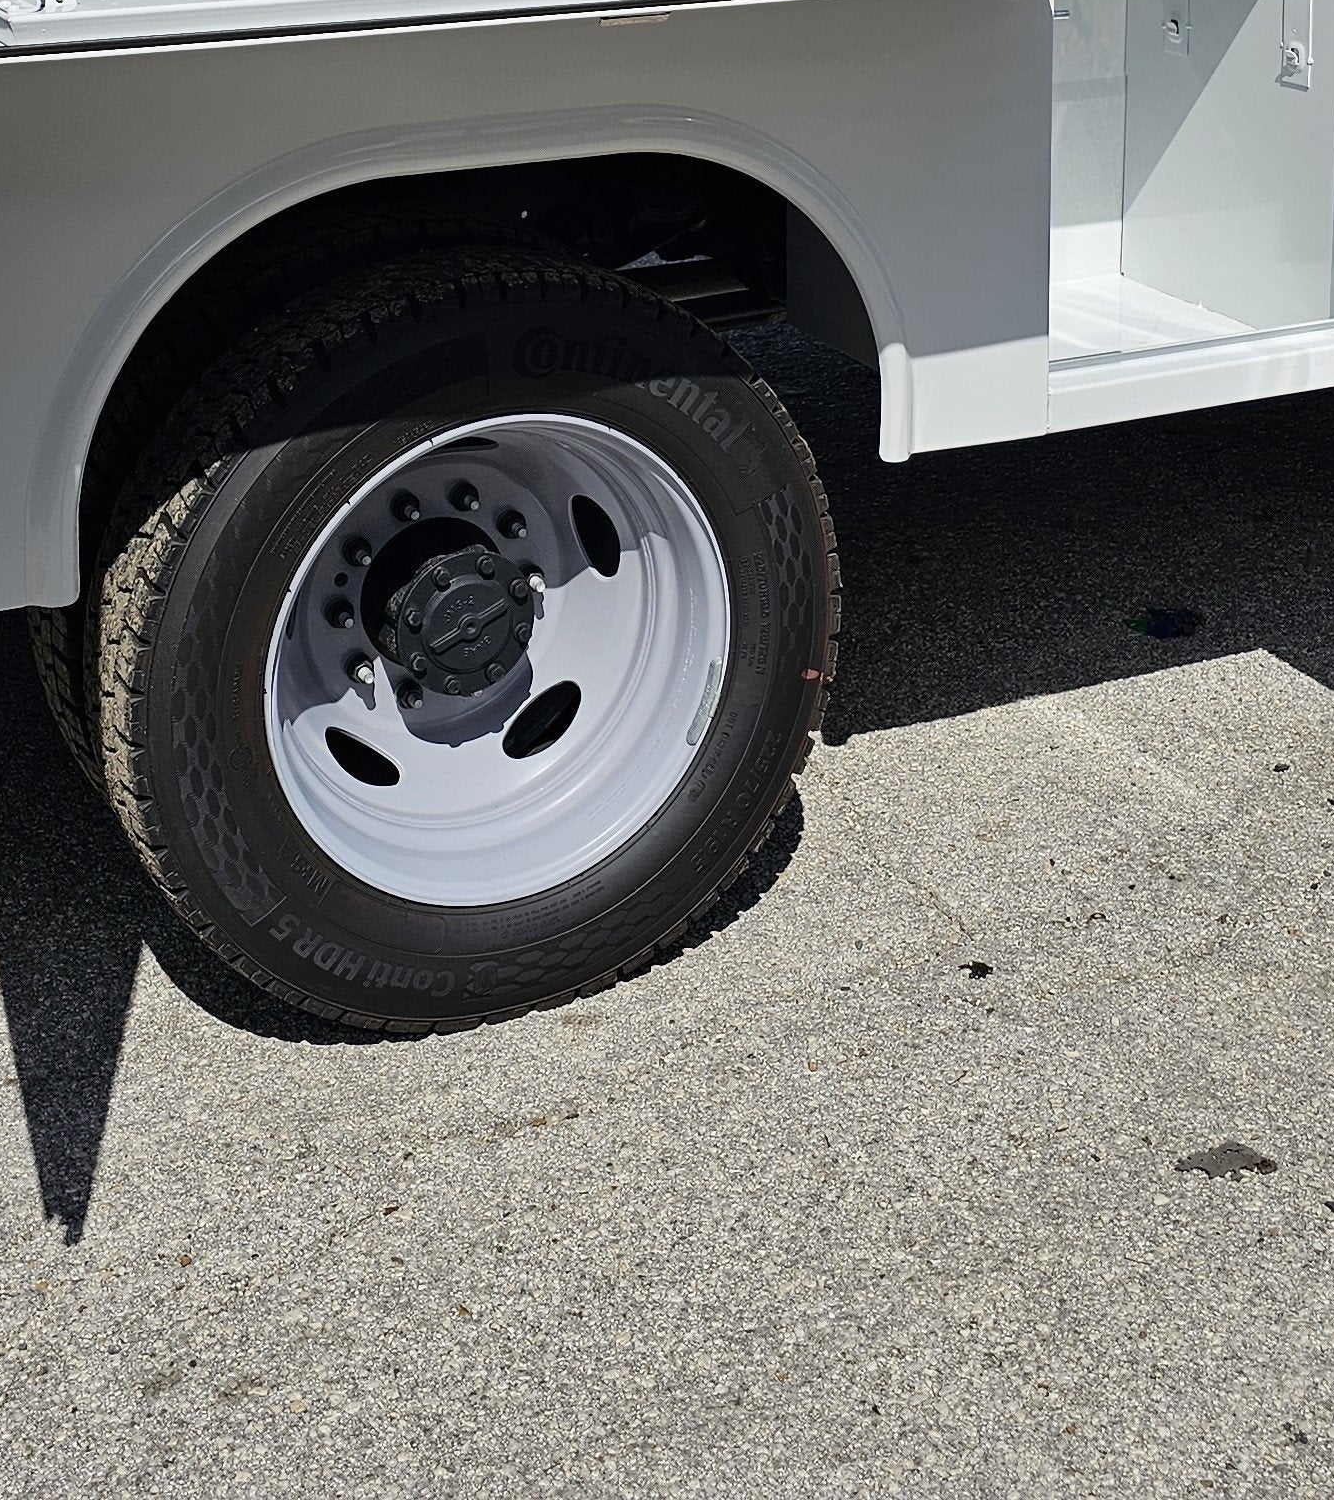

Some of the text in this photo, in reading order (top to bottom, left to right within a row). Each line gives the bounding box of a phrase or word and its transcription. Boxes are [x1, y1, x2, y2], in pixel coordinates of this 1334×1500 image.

[512, 326, 753, 453] Continental
[268, 913, 456, 998] Conti HDR 5
